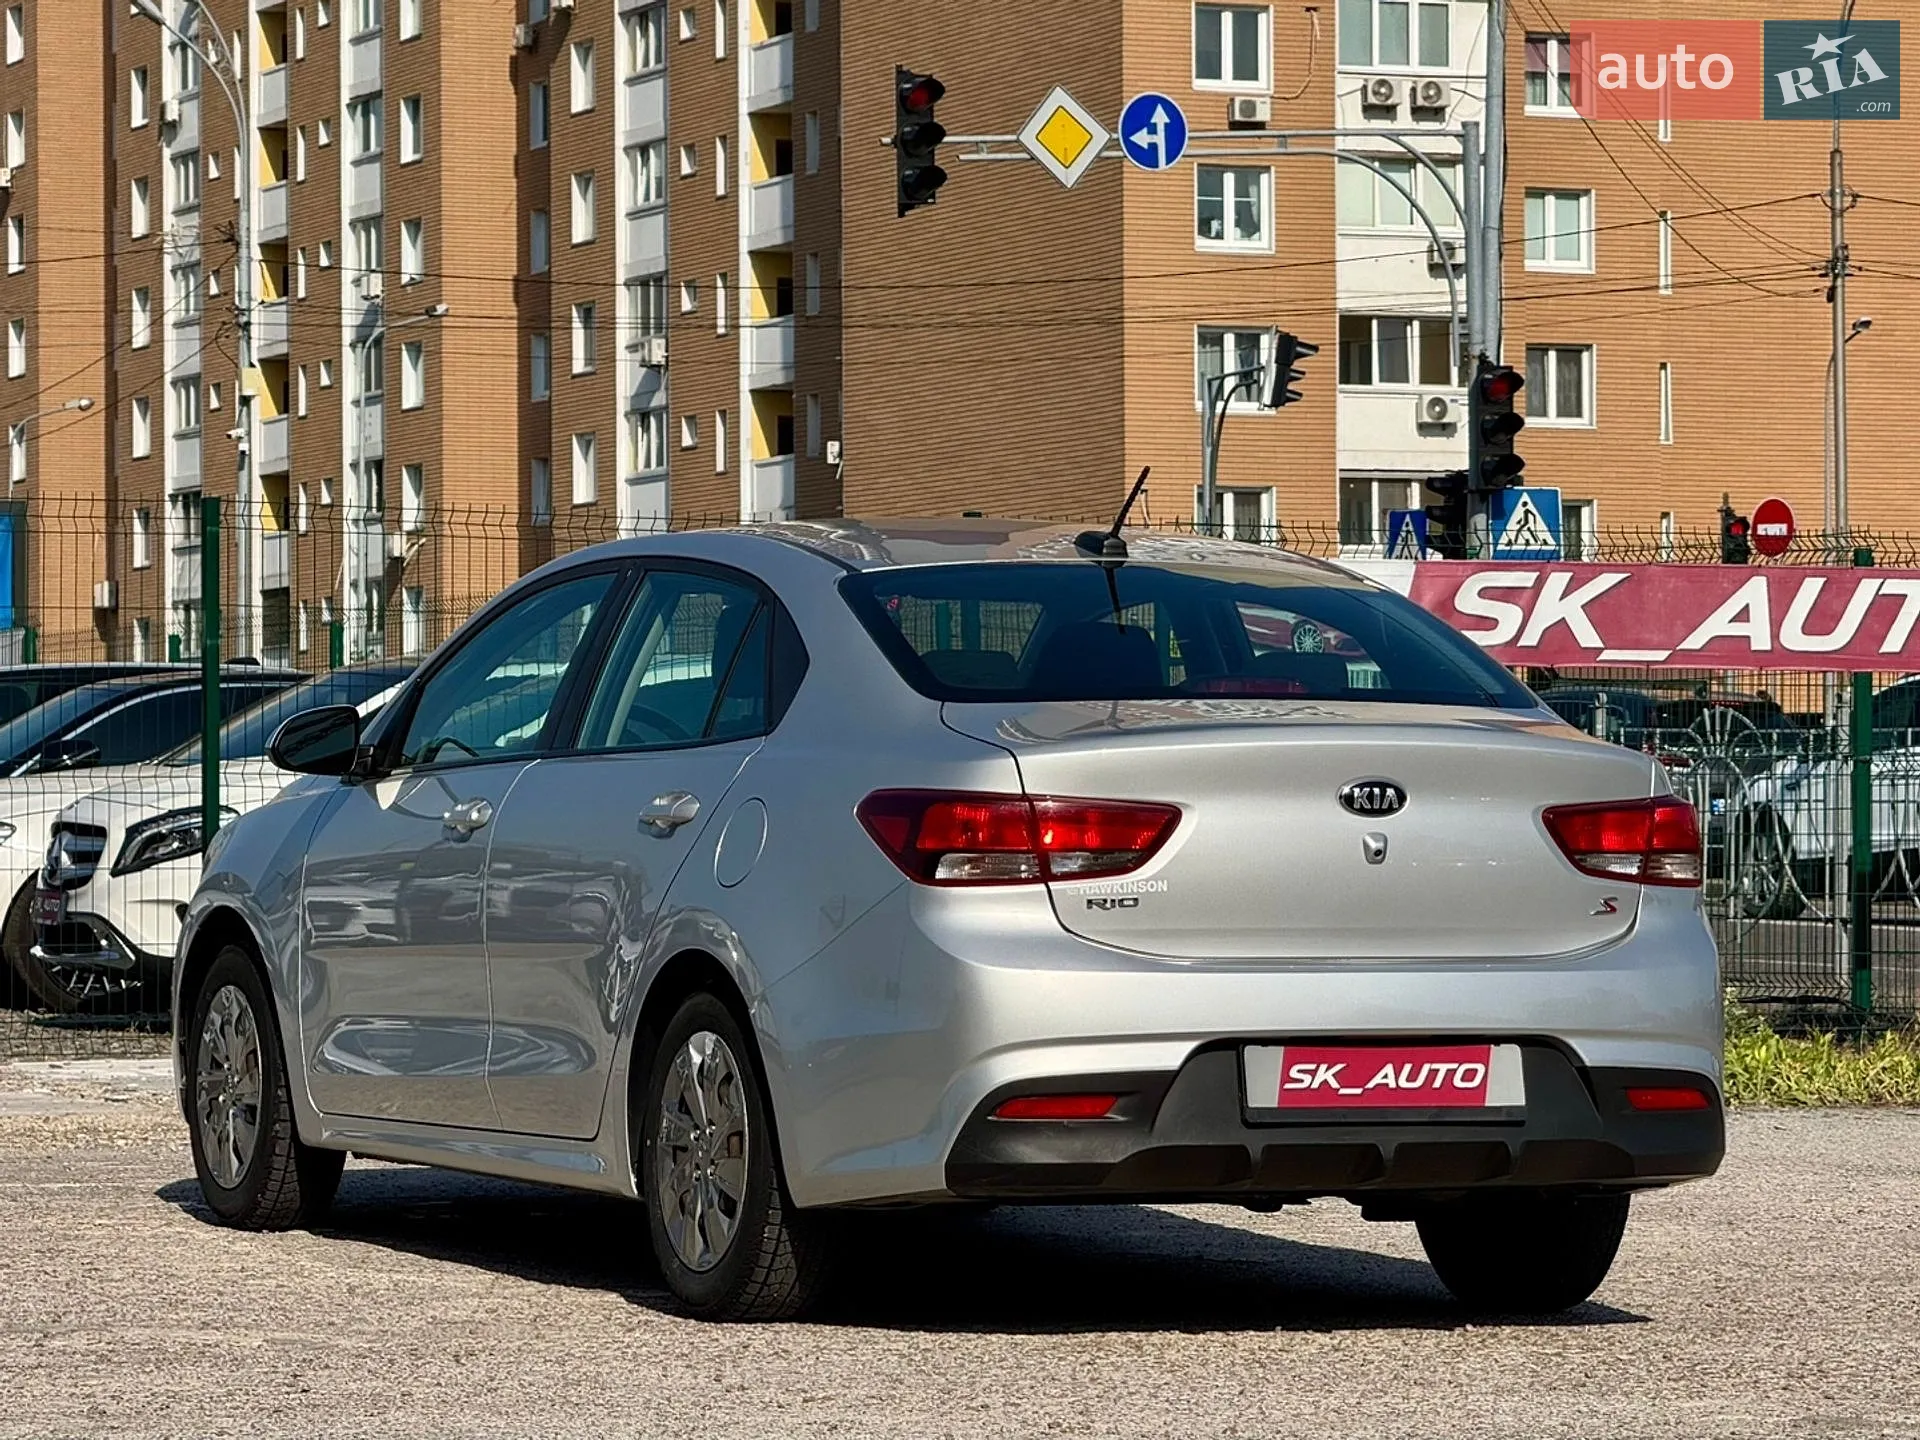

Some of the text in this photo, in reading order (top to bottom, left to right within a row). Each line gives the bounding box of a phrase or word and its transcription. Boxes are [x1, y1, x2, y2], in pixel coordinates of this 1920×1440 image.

[1352, 787, 1399, 809] KIA
[1086, 897, 1140, 911] RIO
[1283, 1062, 1487, 1095] SK_AUTO
